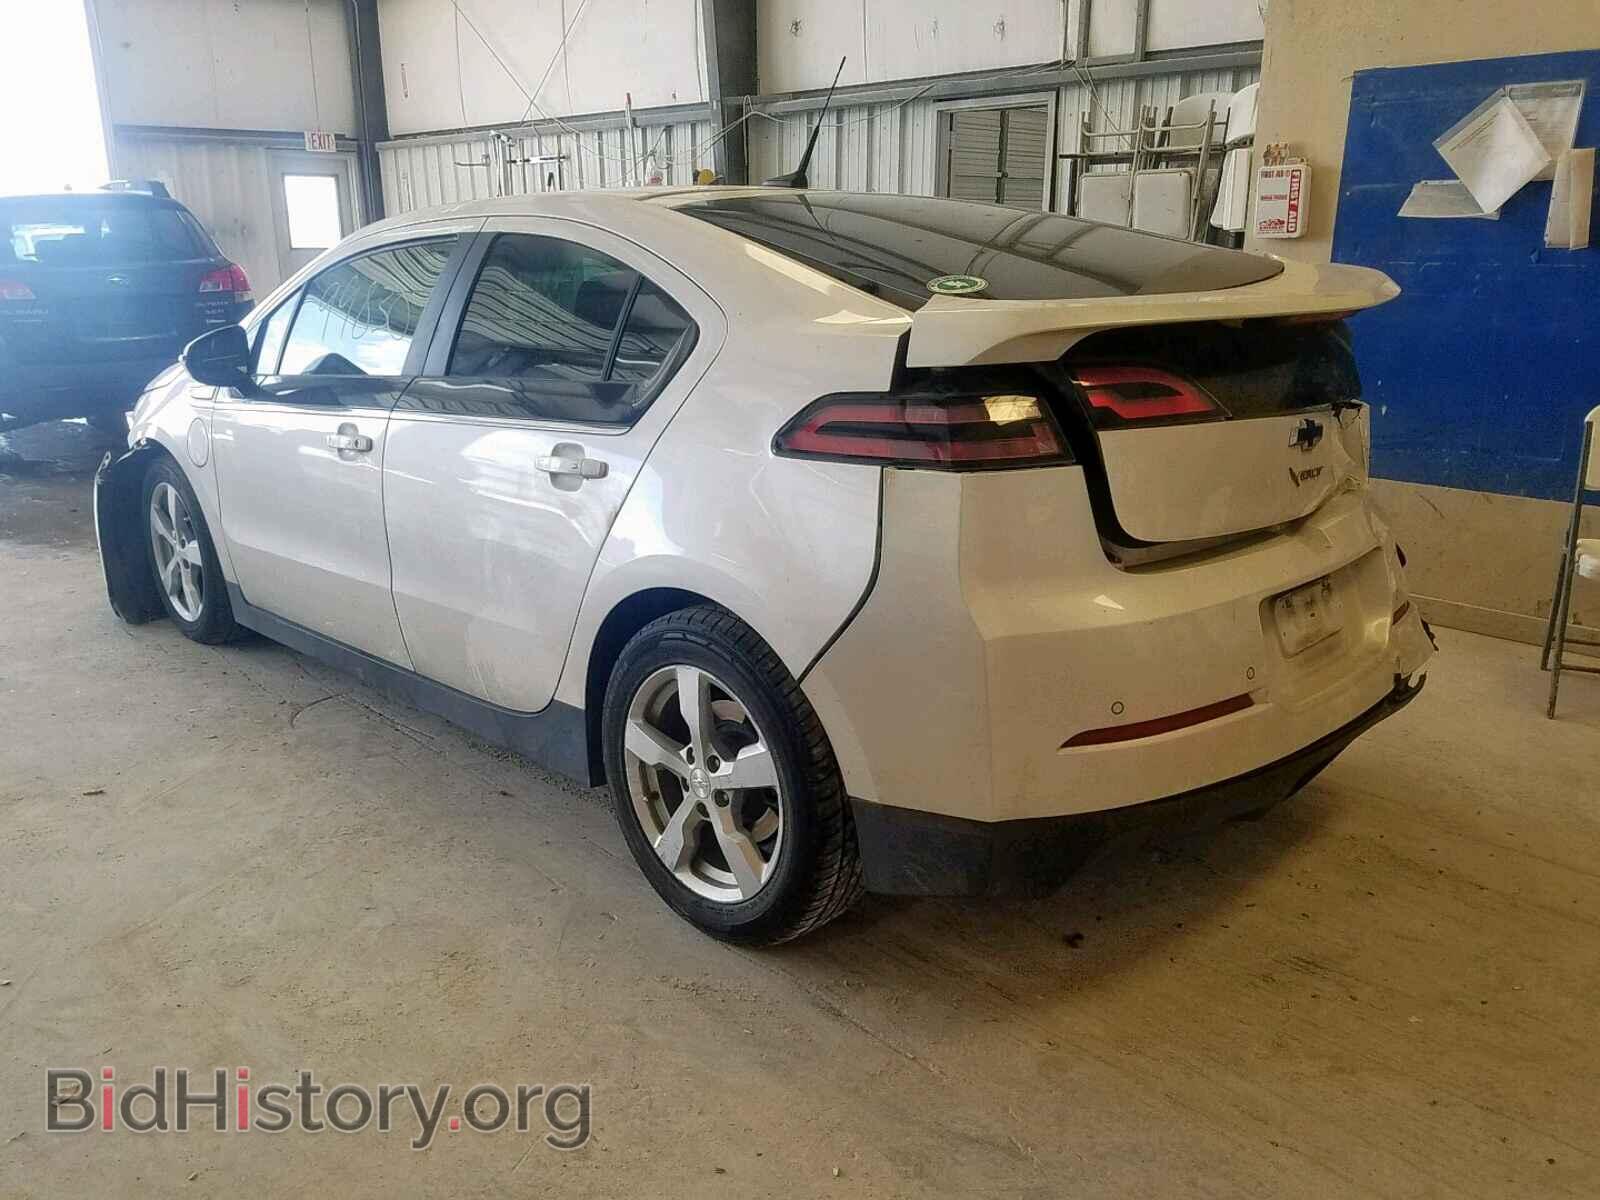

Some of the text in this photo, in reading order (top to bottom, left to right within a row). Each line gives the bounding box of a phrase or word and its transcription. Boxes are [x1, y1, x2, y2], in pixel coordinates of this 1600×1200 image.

[311, 132, 333, 150] EXIT
[1288, 171, 1301, 232] FIRST AID
